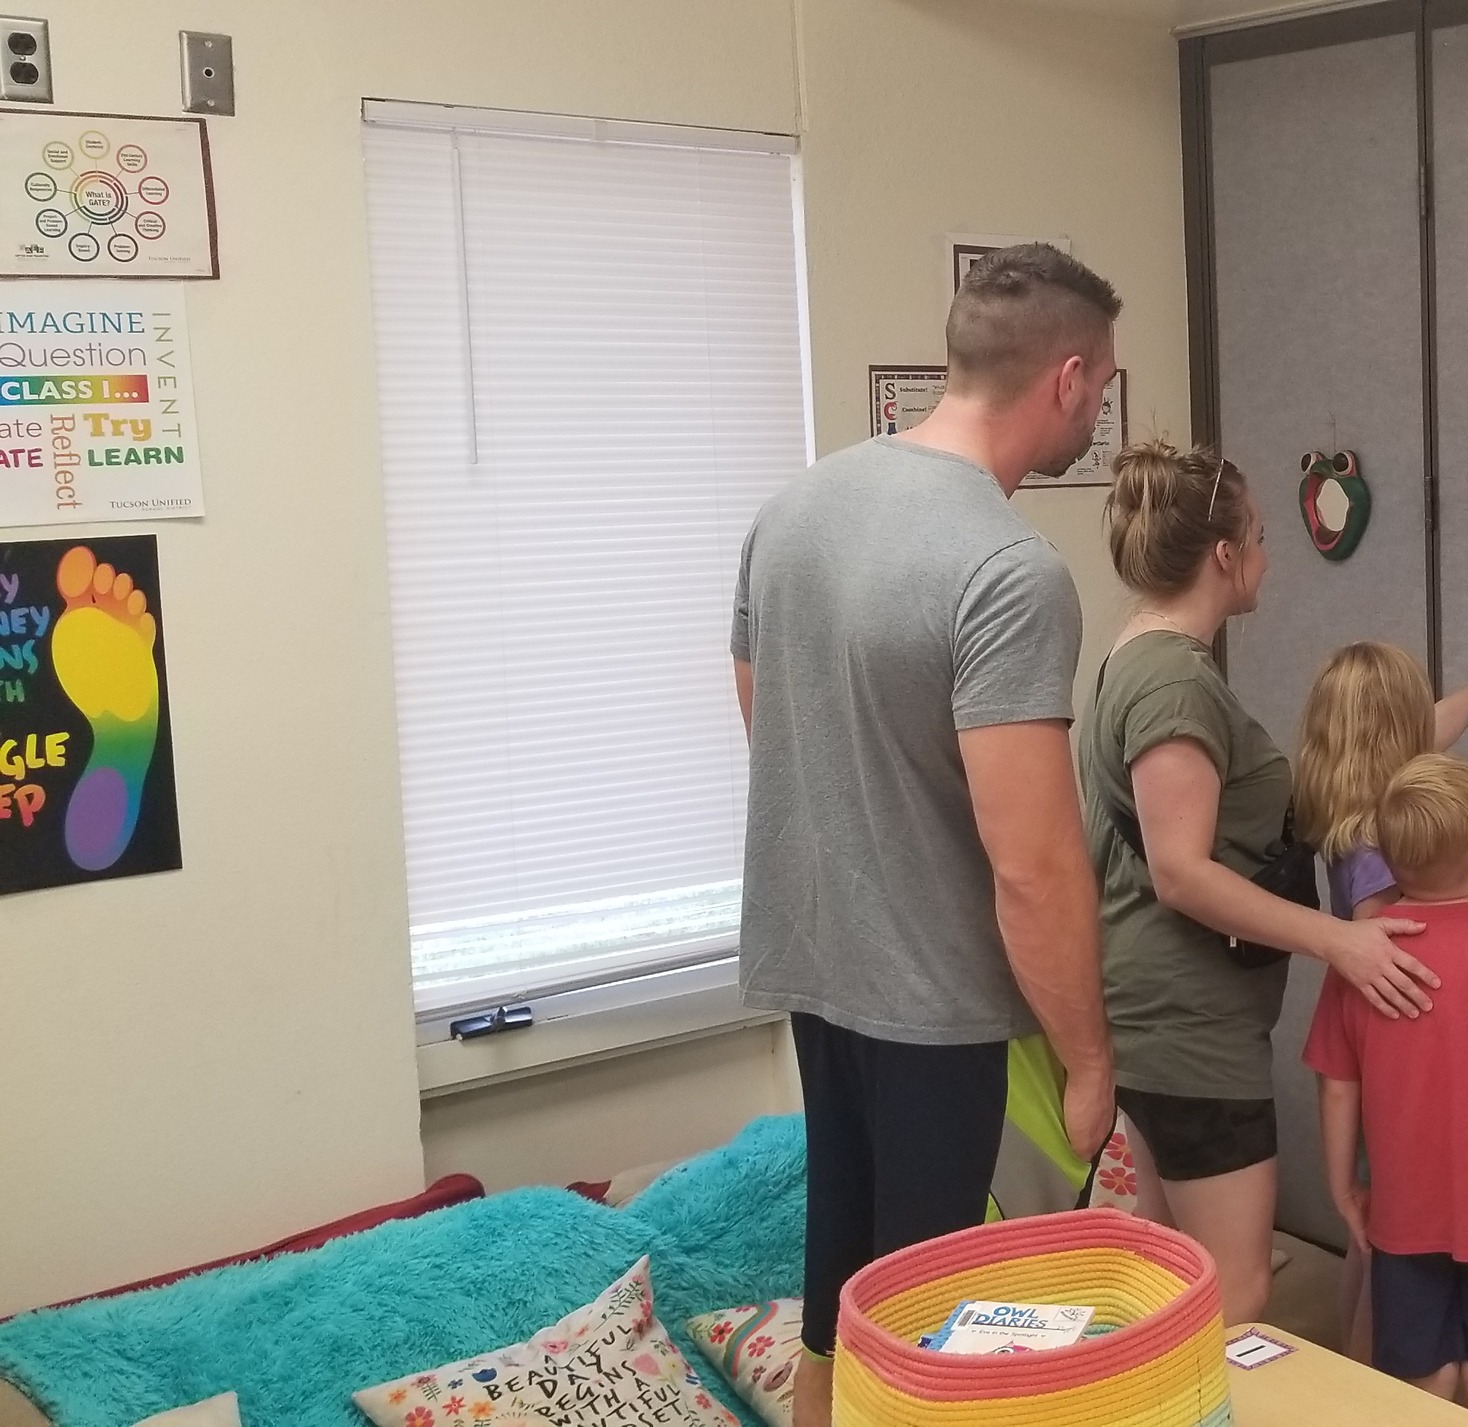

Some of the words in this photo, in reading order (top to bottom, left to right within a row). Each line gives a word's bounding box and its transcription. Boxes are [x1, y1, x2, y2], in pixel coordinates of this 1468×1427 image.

[86, 191, 104, 200] What
[105, 191, 112, 200] is
[89, 199, 111, 207] GATE?
[0, 342, 147, 367] Question
[152, 312, 182, 438] INVENT
[1, 380, 93, 400] CLASS
[885, 382, 897, 400] S
[83, 412, 152, 441] Try
[50, 413, 82, 510] Reflect
[87, 446, 185, 467] LEARN
[110, 500, 149, 509] TUCSON
[152, 498, 192, 507] UNIFIED
[972, 1312, 1049, 1328] DIARIES
[993, 1305, 1039, 1319] OWL
[482, 1325, 633, 1401] BEAUTIFUL
[537, 1355, 604, 1399] DAY
[534, 1360, 637, 1419] BEGINS
[549, 1388, 621, 1427] WITH
[634, 1377, 650, 1392] A
